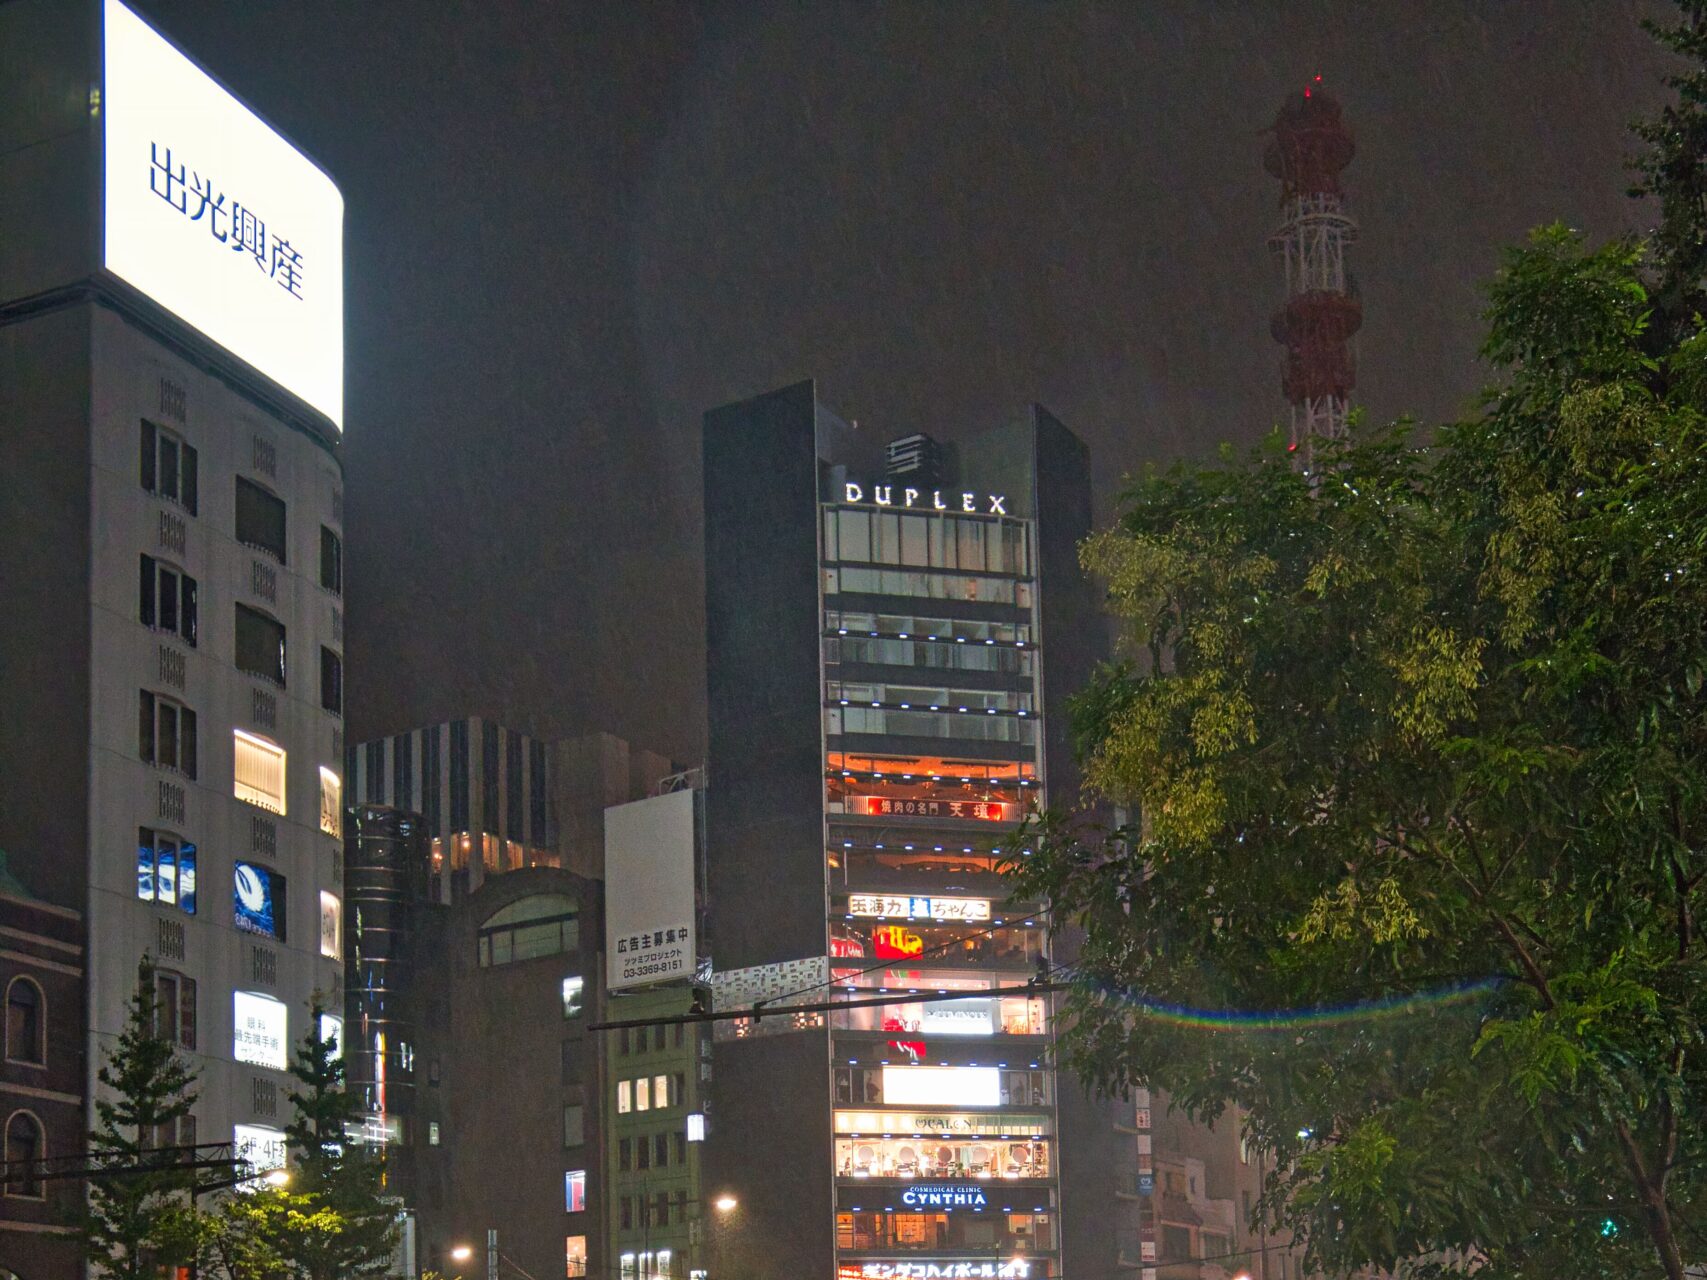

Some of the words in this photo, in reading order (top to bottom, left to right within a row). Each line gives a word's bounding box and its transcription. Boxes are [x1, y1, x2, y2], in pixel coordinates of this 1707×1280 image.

[150, 138, 303, 301] 出光興産
[846, 483, 1006, 515] DUPLEX
[881, 799, 939, 815] 焼肉の名門
[617, 926, 688, 953] 広告主募集中
[903, 1192, 986, 1204] CYNTHIA
